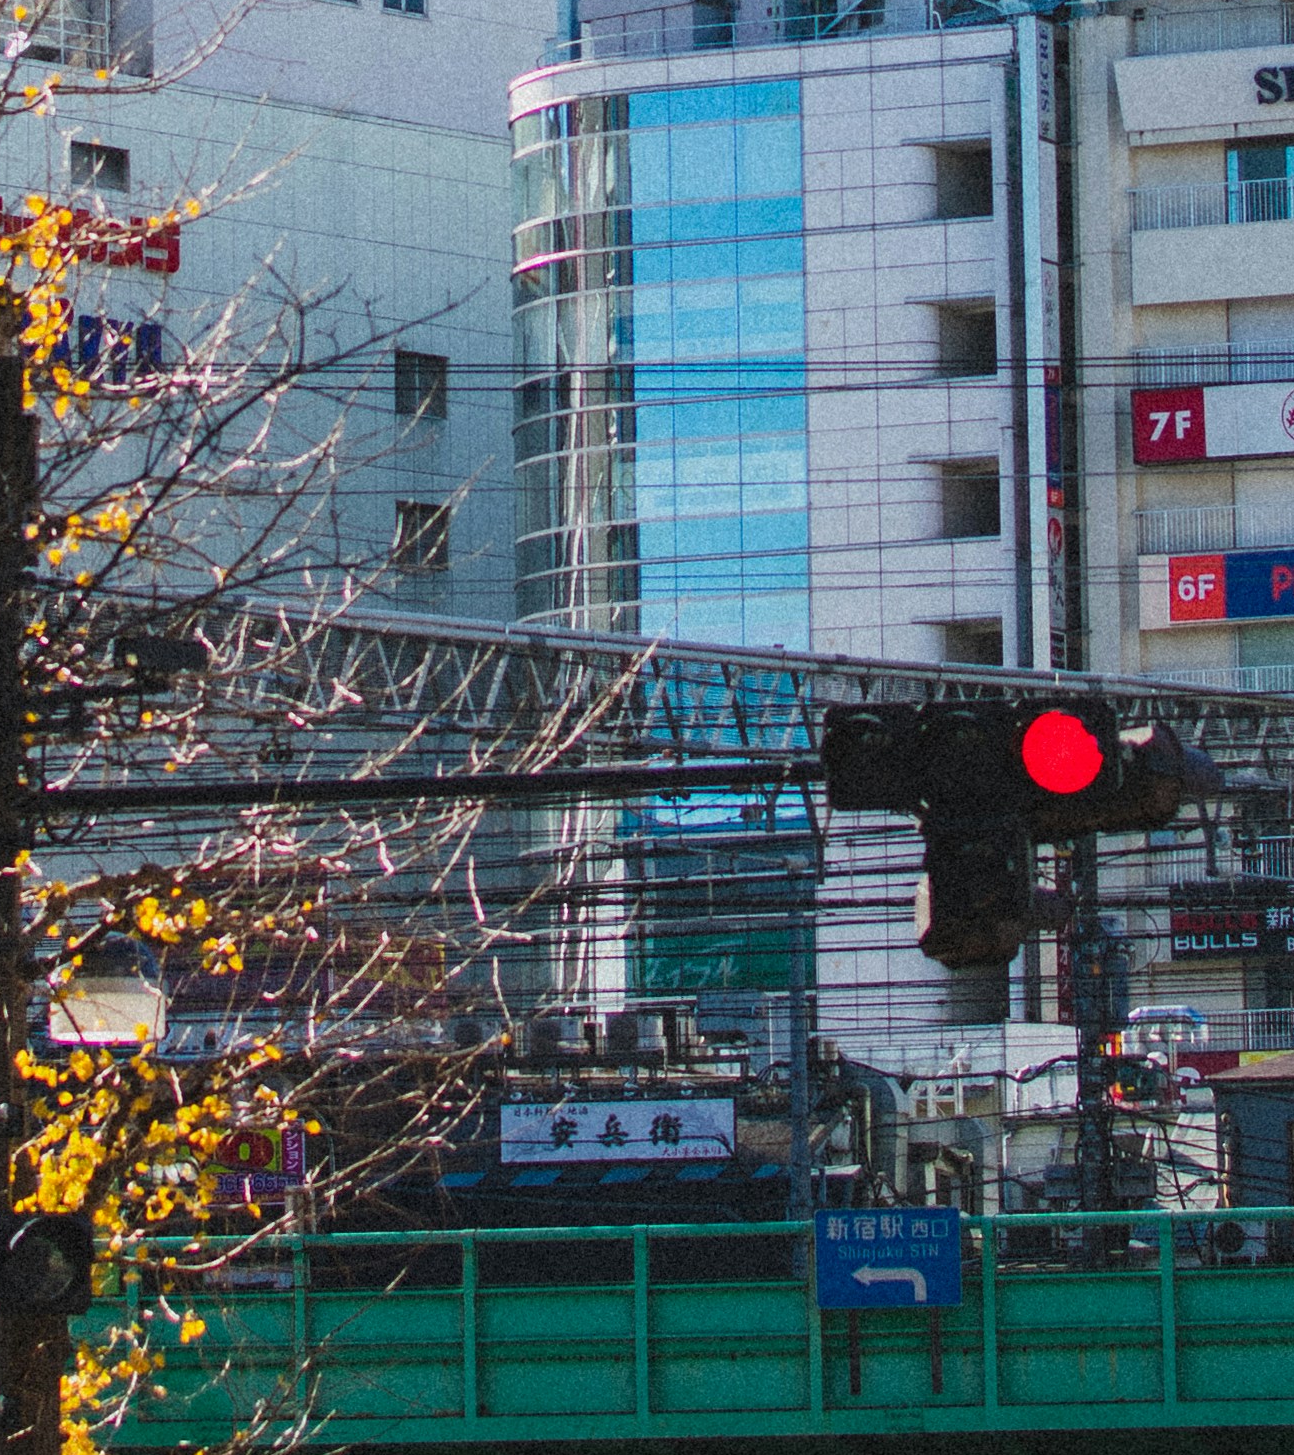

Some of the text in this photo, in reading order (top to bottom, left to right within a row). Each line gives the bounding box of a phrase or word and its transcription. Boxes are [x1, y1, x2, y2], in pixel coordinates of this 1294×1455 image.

[1149, 410, 1191, 441] 7F
[1178, 573, 1215, 601] 6F
[1174, 932, 1257, 951] BULLS
[838, 1244, 939, 1261] Shinjuku STN
